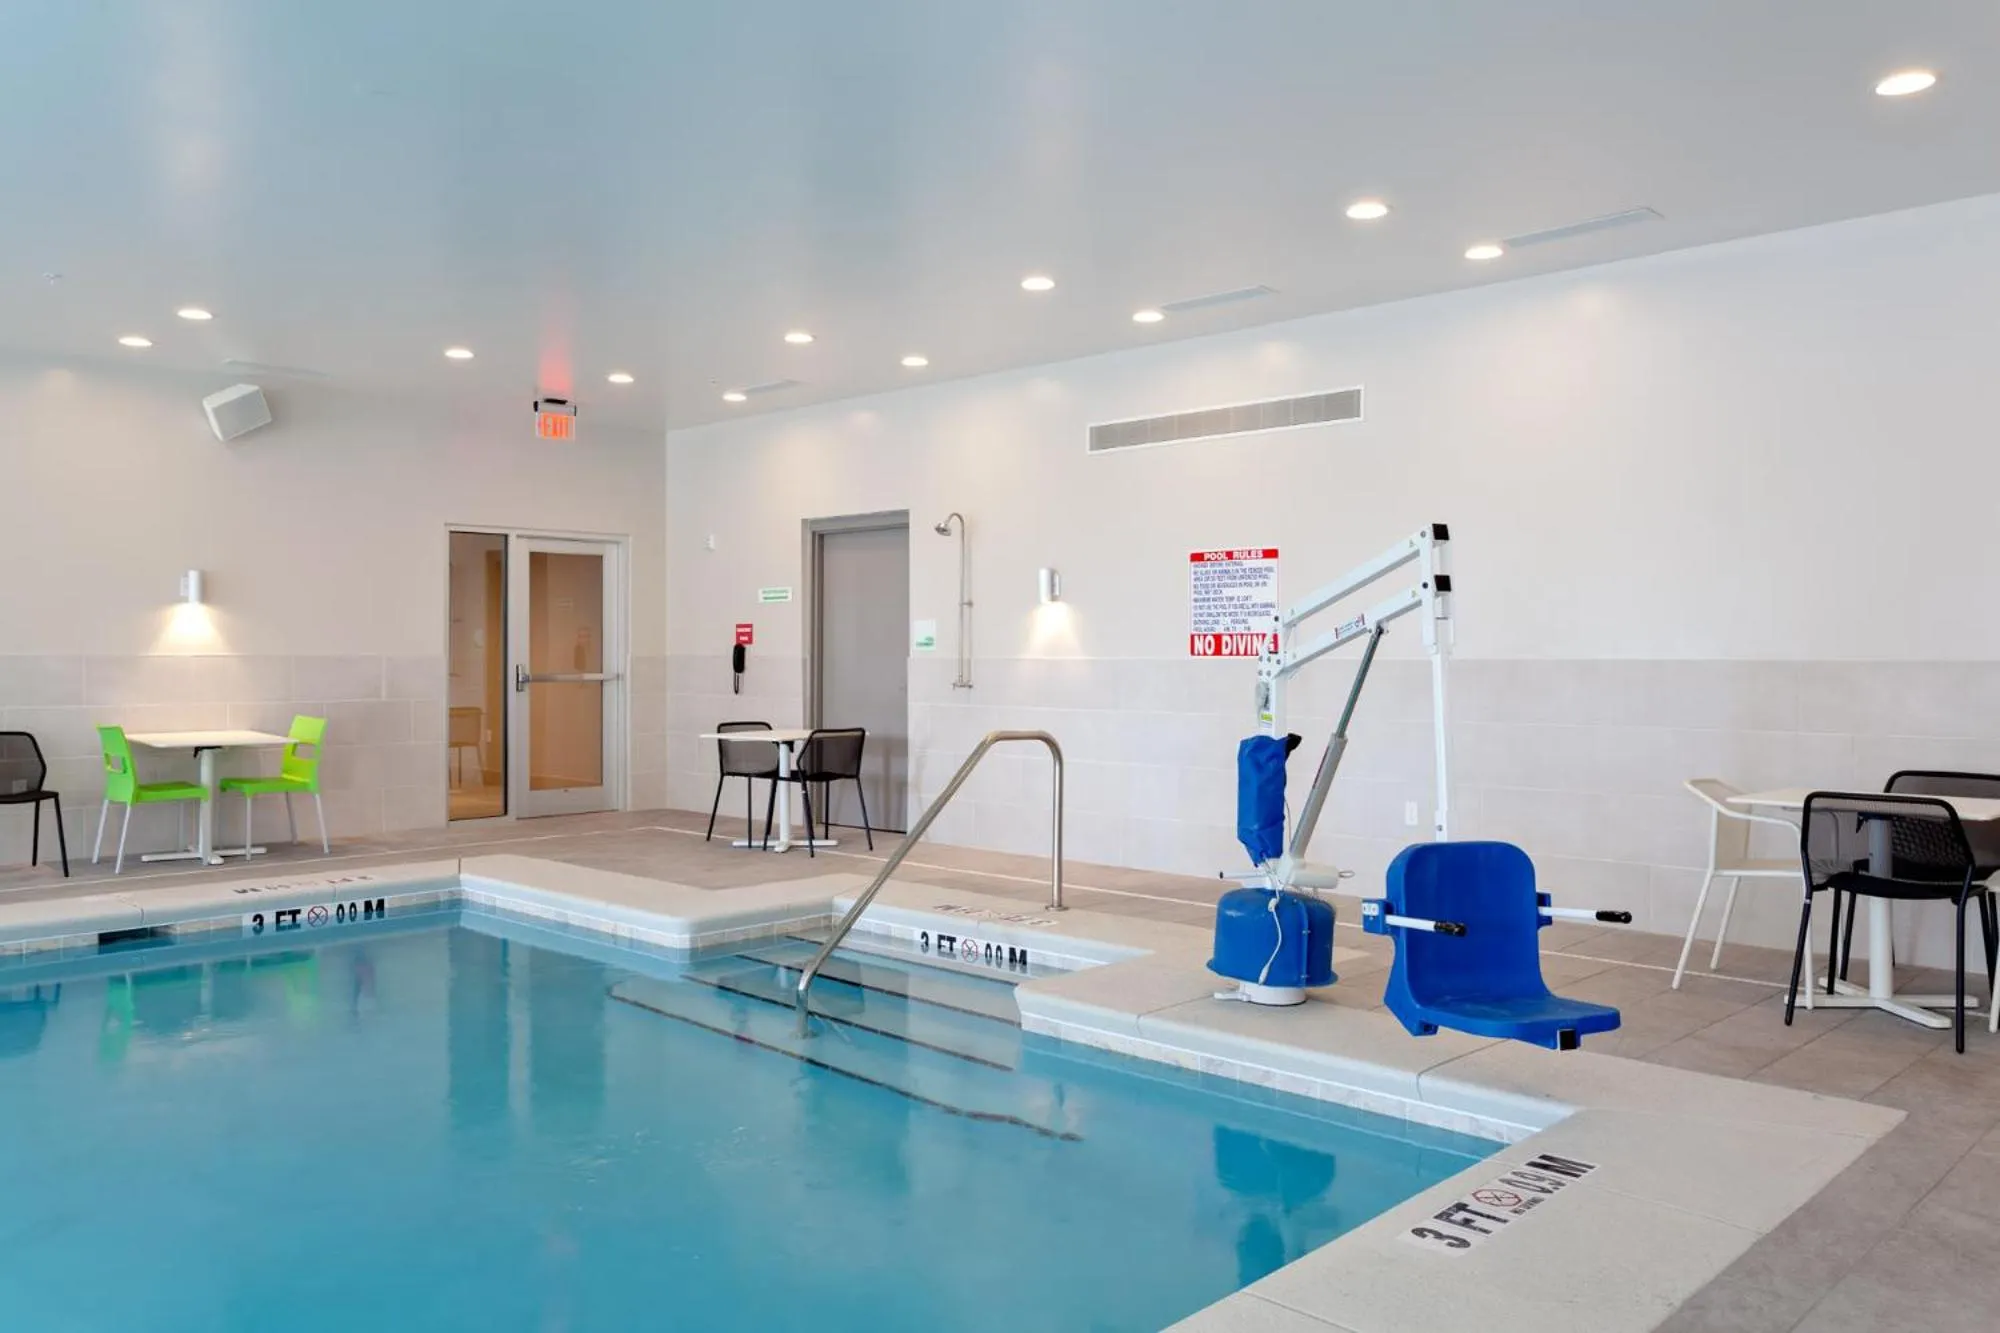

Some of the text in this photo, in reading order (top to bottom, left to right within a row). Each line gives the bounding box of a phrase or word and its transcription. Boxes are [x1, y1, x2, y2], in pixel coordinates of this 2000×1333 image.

[542, 414, 569, 438] EXIT
[1204, 549, 1263, 561] POOL RULES
[1194, 634, 1216, 655] NO
[1433, 1202, 1509, 1235] FT
[1411, 1227, 1471, 1249] 3
